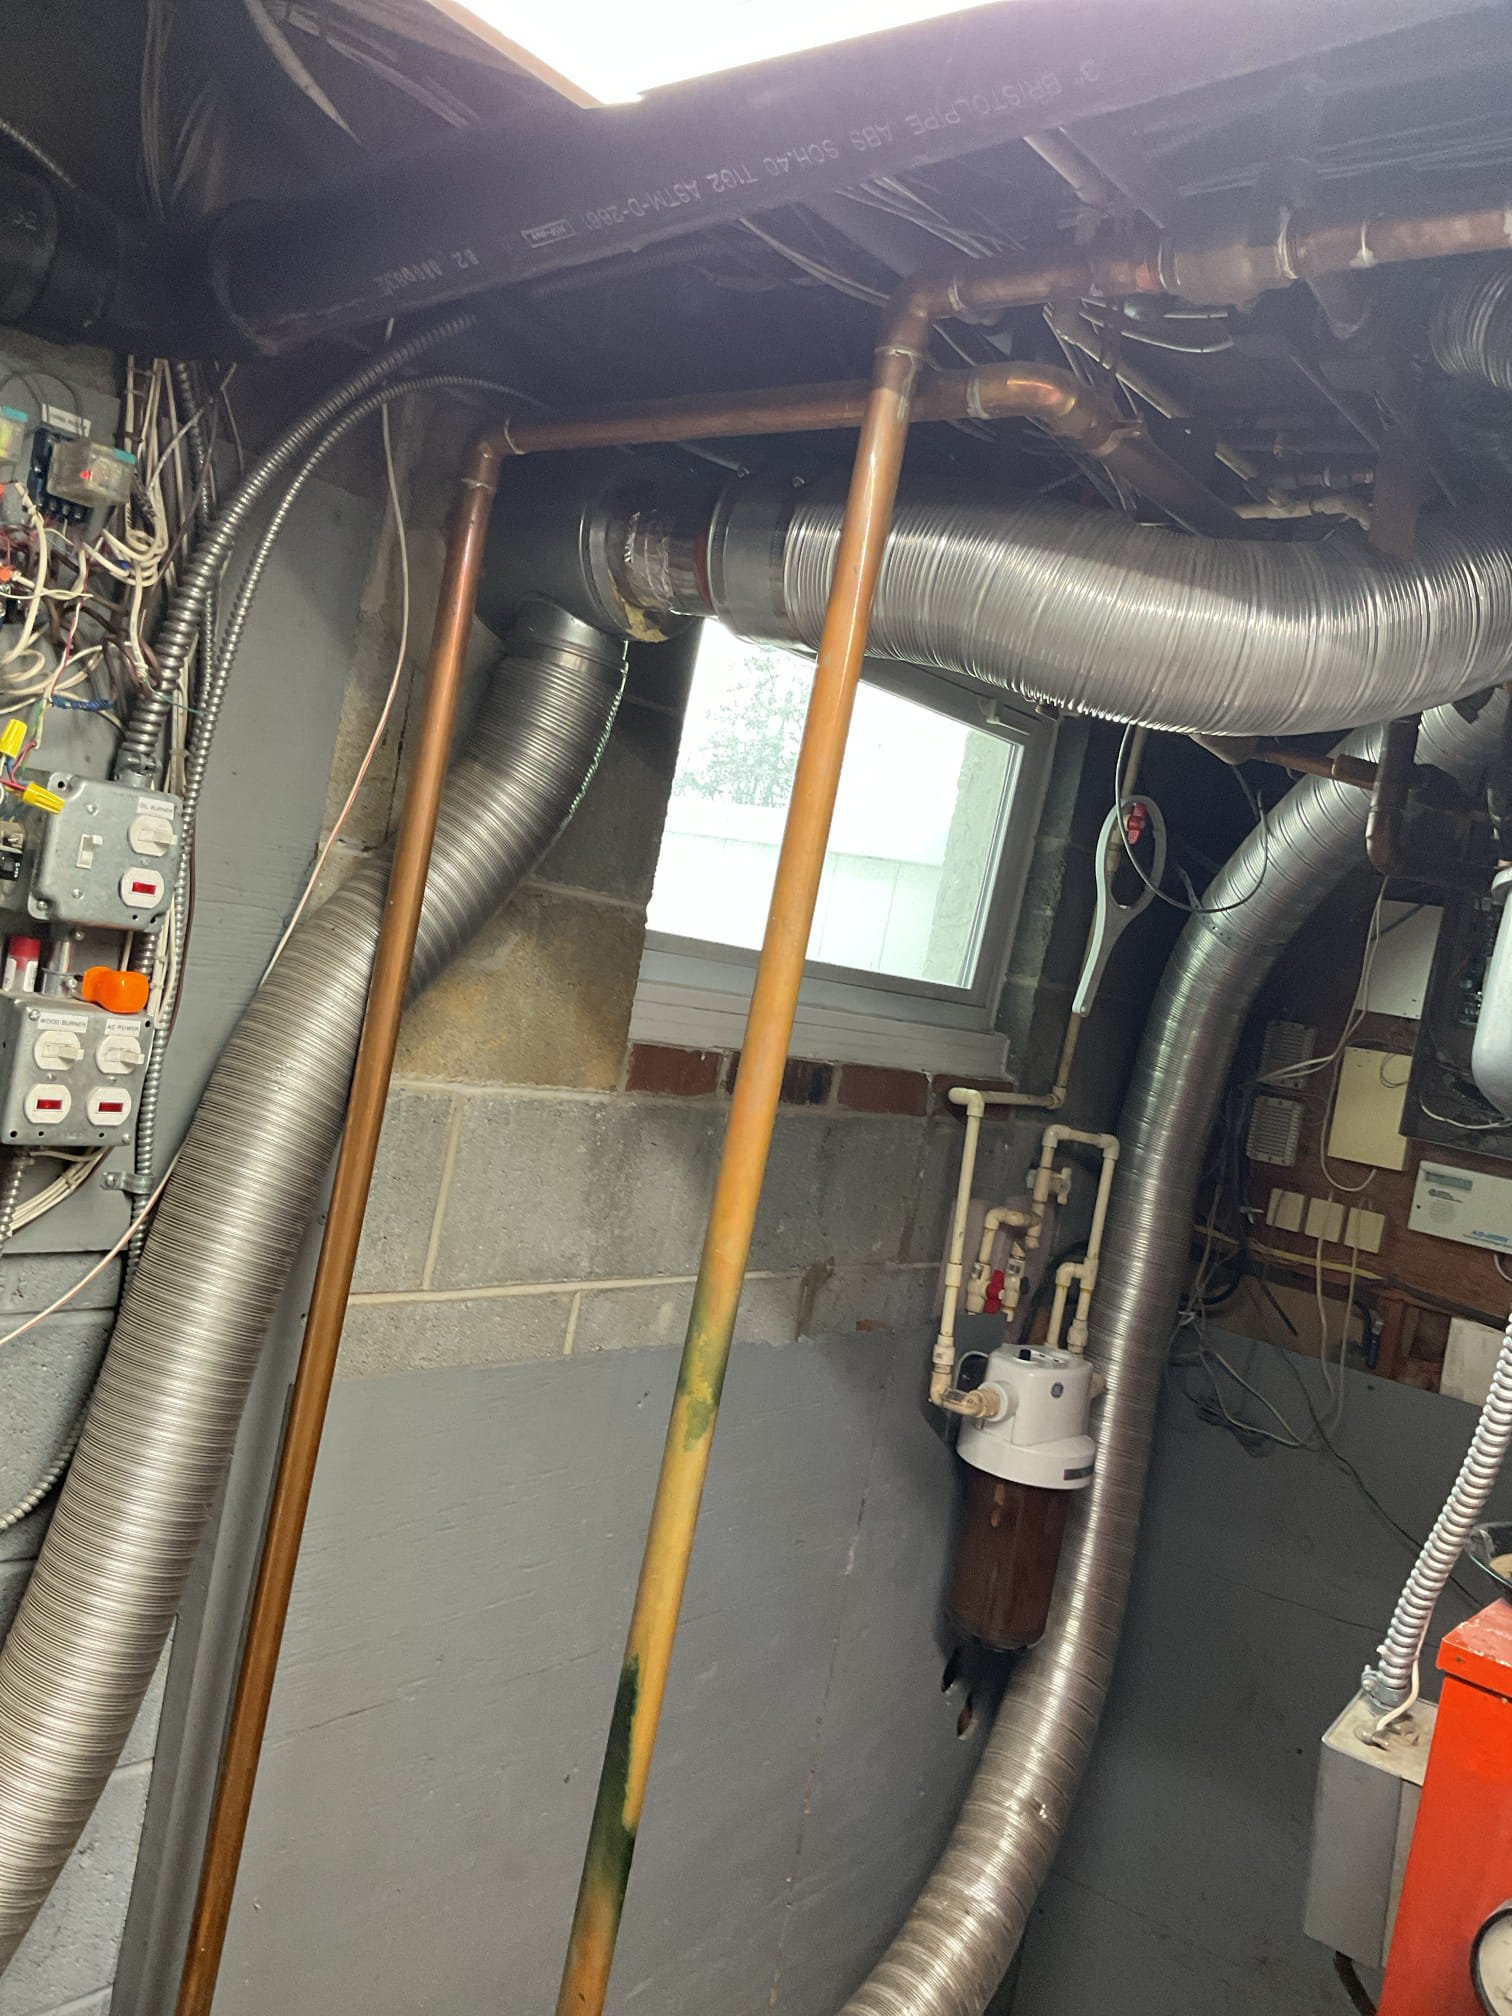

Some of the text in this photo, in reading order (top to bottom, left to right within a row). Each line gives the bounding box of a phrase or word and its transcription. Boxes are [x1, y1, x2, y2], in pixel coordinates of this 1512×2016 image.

[851, 119, 893, 151] ABS
[40, 1017, 60, 1026] WOOD
[107, 1024, 140, 1033] AC POWER
